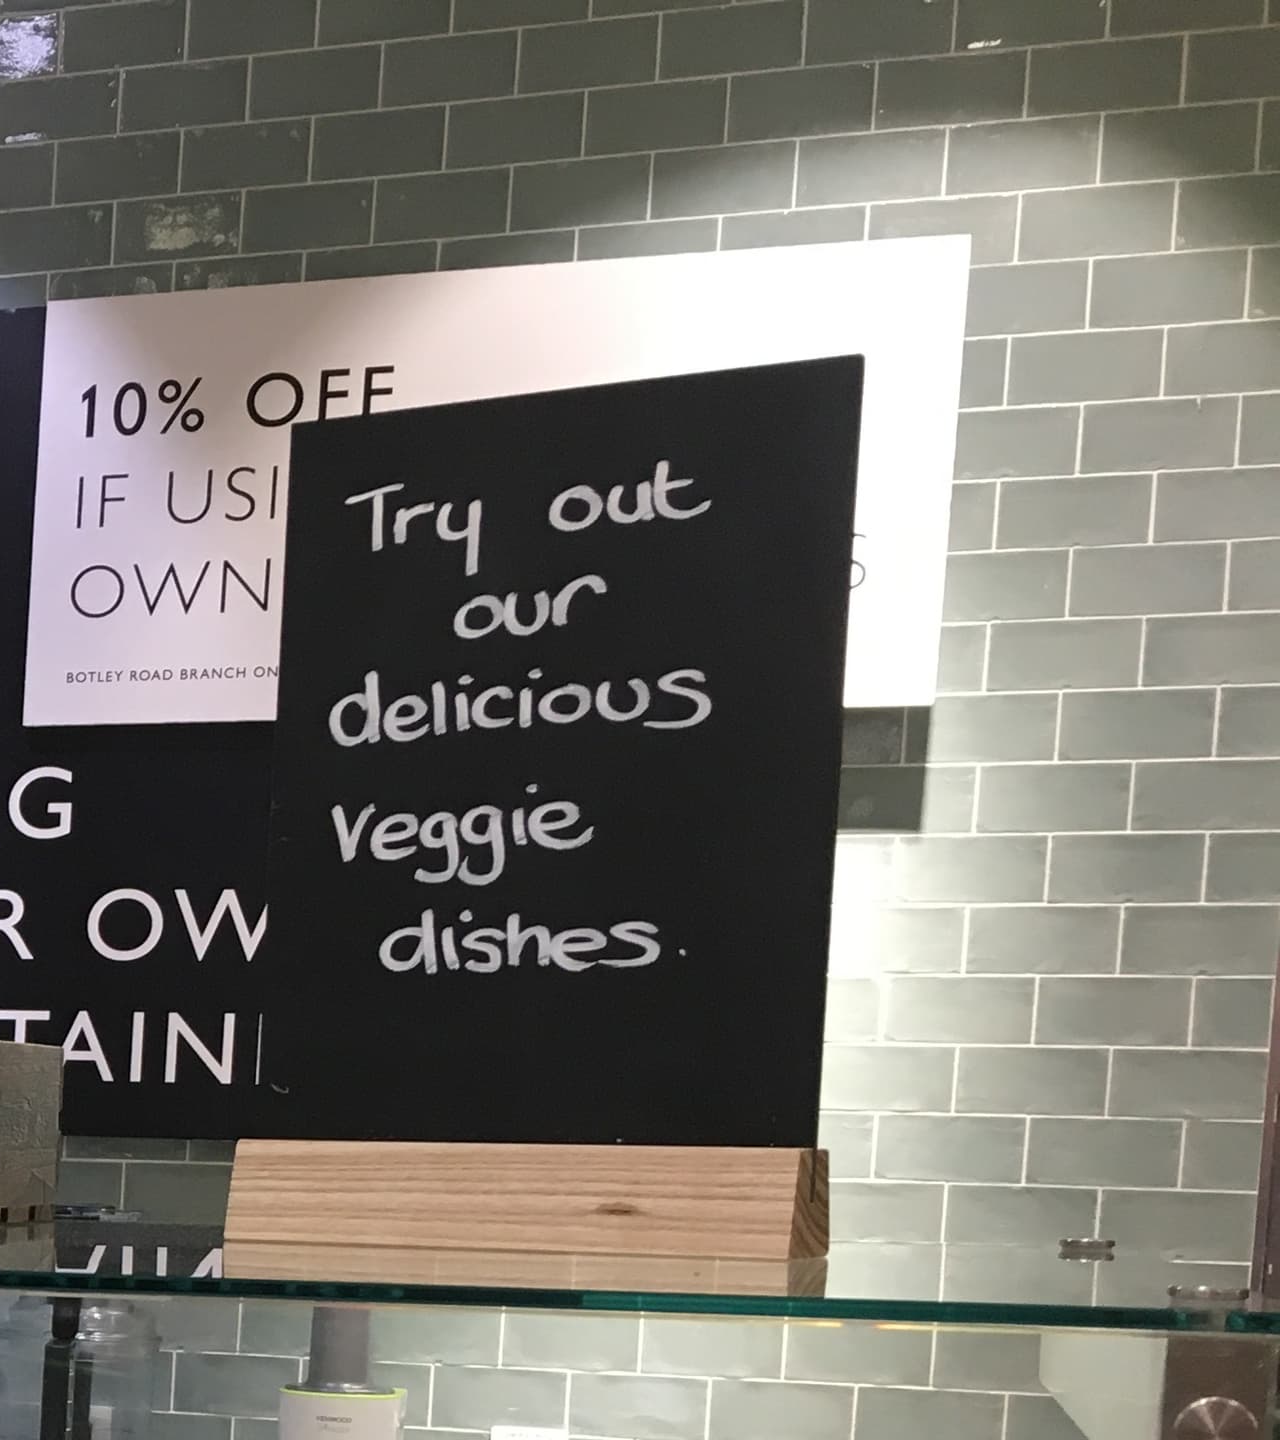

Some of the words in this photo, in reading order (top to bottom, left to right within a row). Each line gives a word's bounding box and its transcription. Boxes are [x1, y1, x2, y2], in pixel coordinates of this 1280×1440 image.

[80, 376, 206, 438] 10%
[245, 365, 395, 428] OFF
[76, 472, 130, 530] IF
[344, 481, 483, 576] Try
[548, 459, 713, 532] out
[69, 557, 273, 620] OWN
[453, 573, 608, 640] our
[65, 668, 125, 685] BOTLEY
[128, 667, 174, 684] ROAD
[179, 665, 248, 681] BRANCH
[328, 667, 714, 748] delicious
